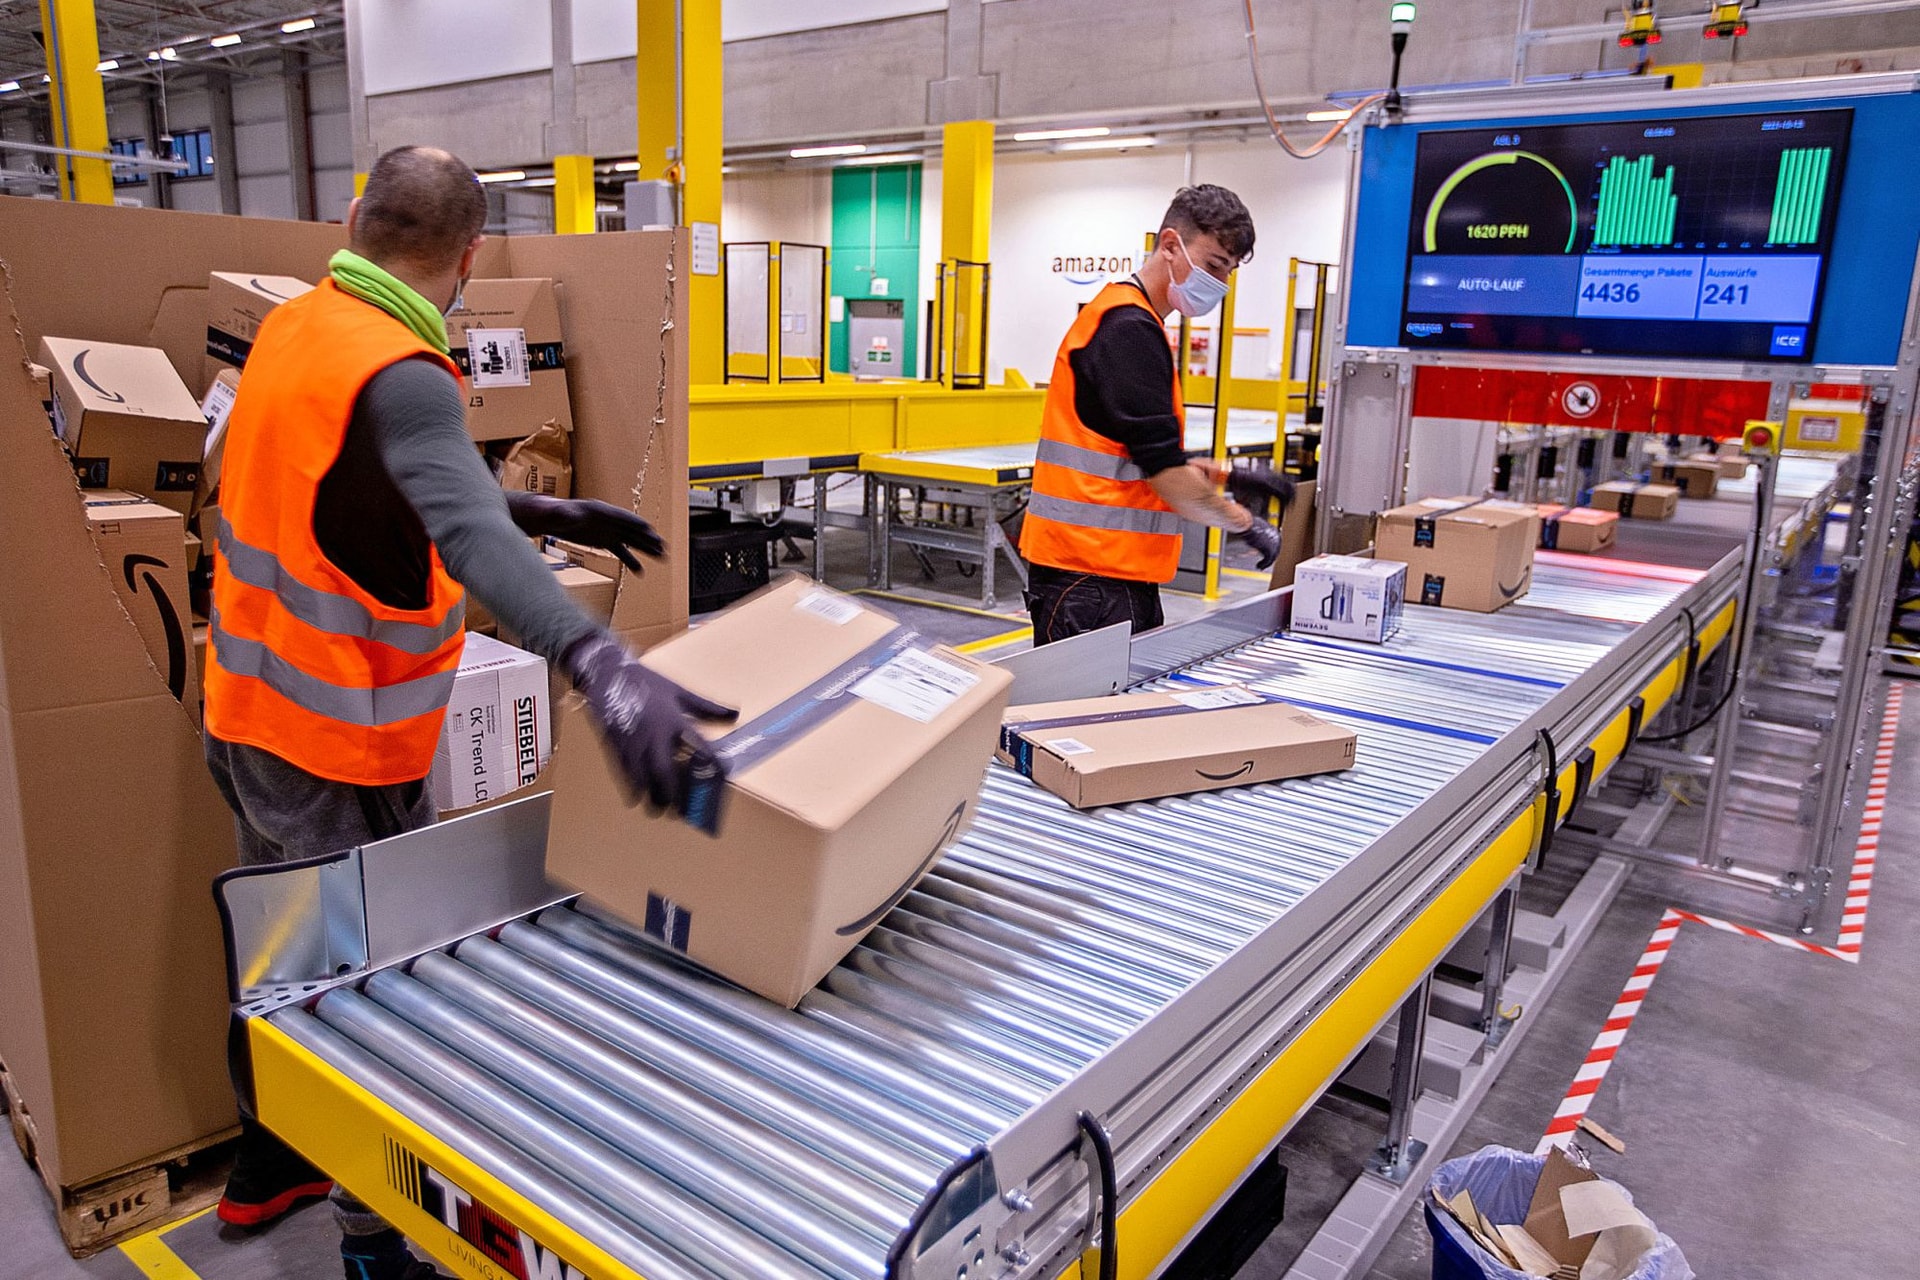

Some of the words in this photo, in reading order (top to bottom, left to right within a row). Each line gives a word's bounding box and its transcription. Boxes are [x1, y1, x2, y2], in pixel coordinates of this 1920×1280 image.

[1466, 224, 1498, 239] 1620
[1499, 224, 1530, 239] PPH
[1052, 256, 1132, 273] amazon
[1584, 267, 1655, 279] Gesamtmenge
[1657, 267, 1693, 277] Pakete
[1581, 282, 1641, 303] 4436
[1703, 284, 1750, 305] 241
[1294, 621, 1329, 631] SEVERIN
[470, 707, 484, 726] CK
[518, 696, 535, 770] STIEBEL
[471, 730, 487, 776] Trend
[448, 1237, 494, 1280] LIVING
